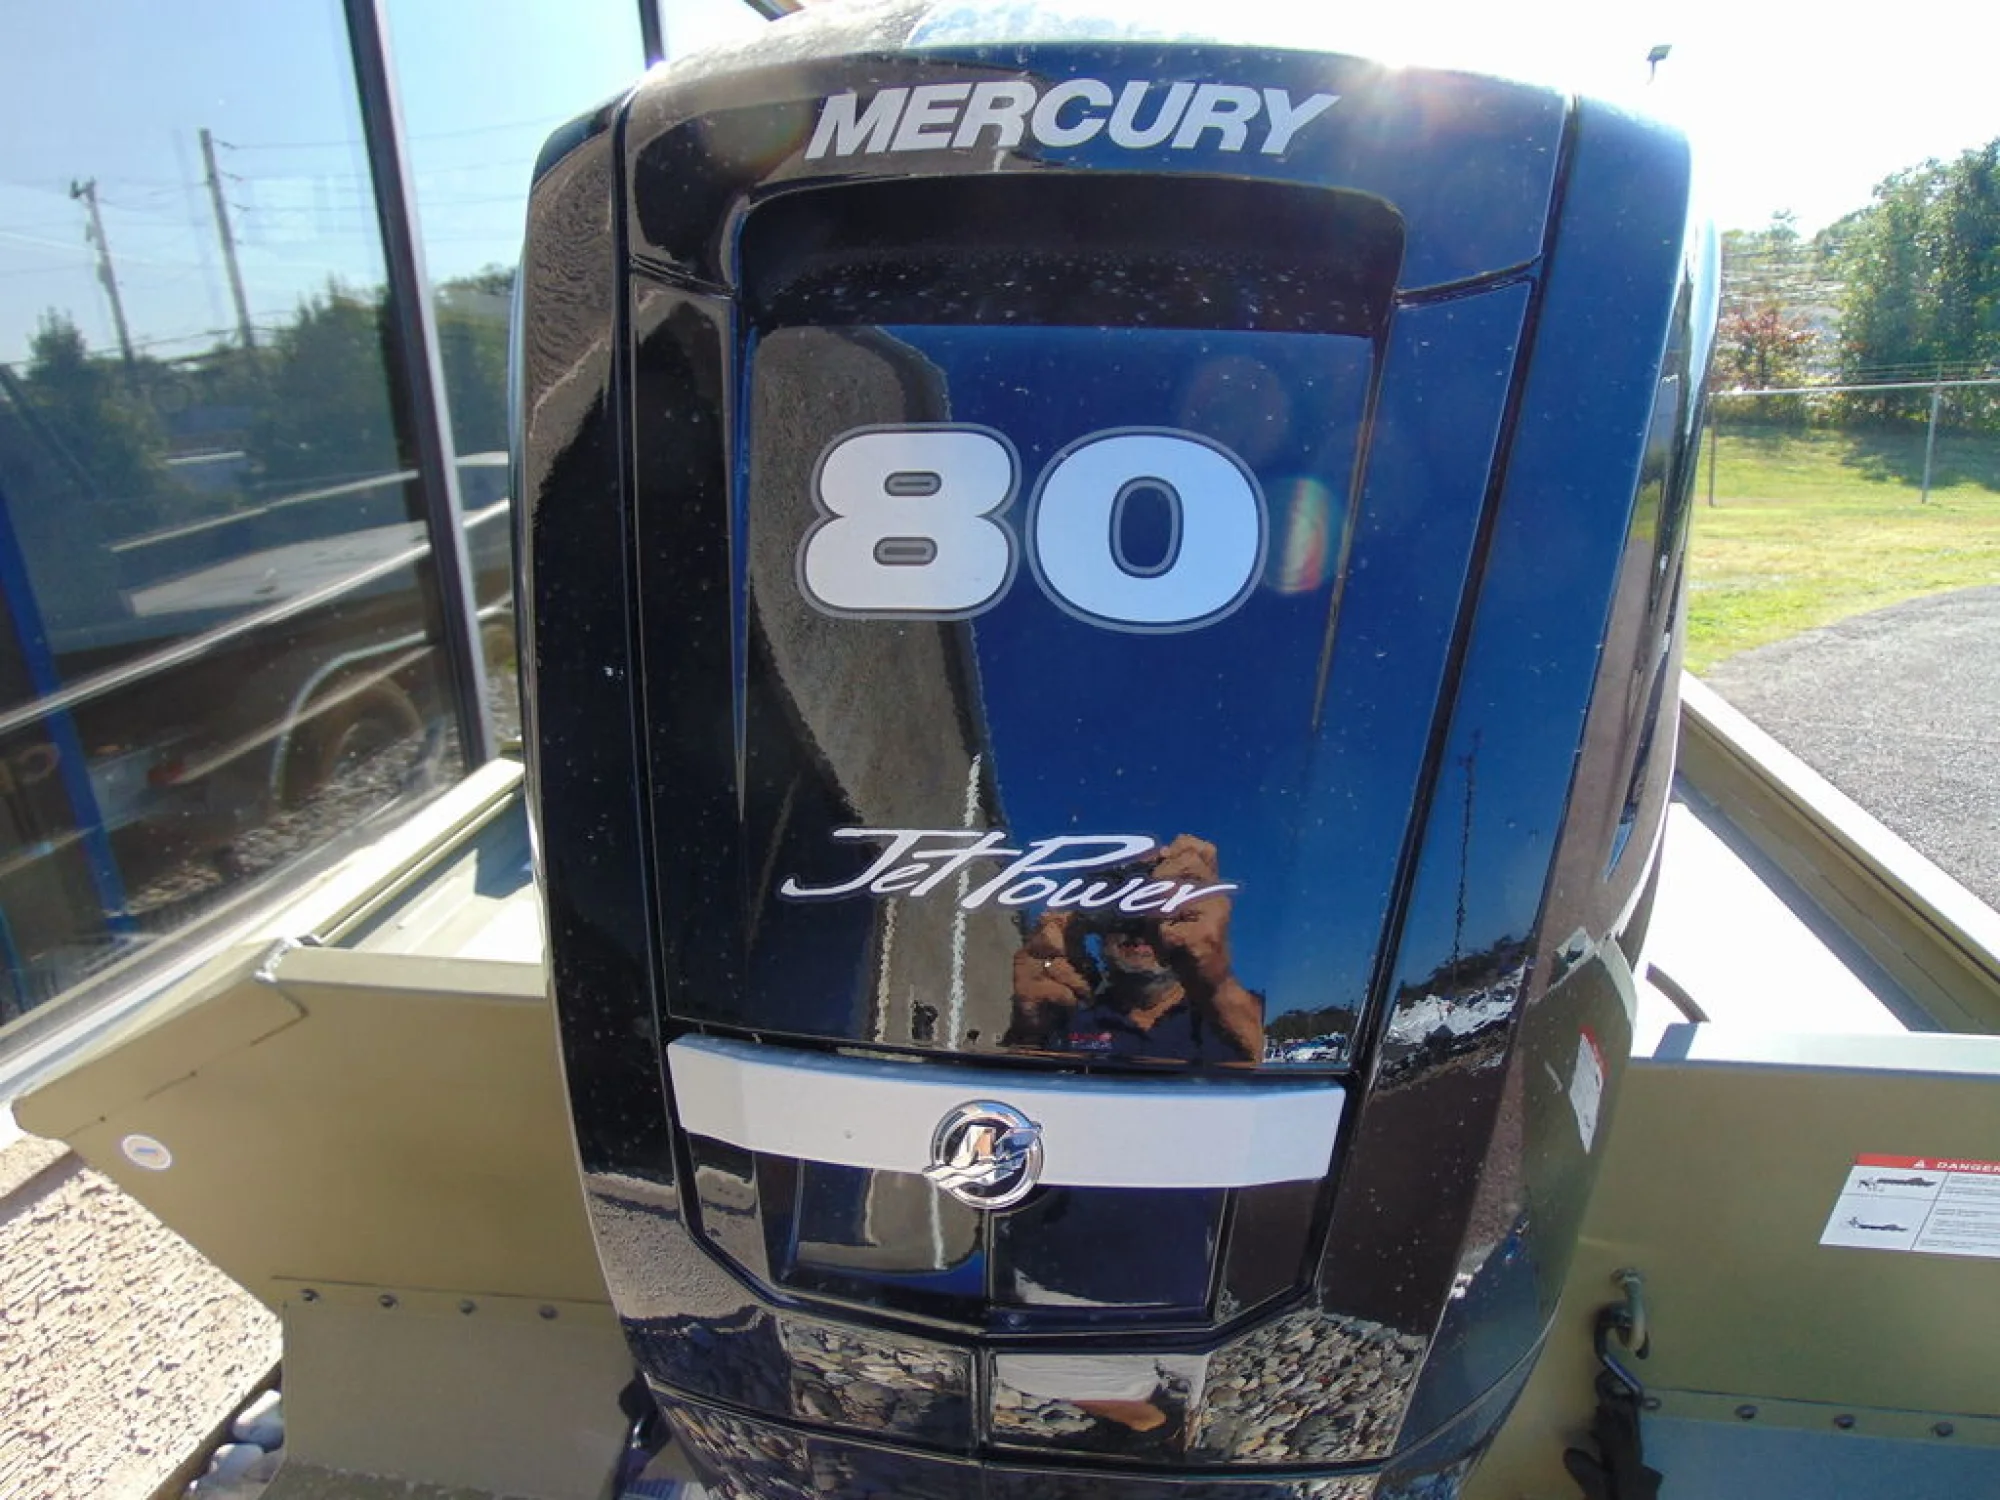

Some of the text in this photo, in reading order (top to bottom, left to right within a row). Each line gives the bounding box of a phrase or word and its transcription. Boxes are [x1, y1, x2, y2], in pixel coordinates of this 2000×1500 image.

[804, 78, 1340, 160] MERCURY
[797, 422, 1270, 633] 80
[1936, 1161, 2000, 1173] DANGER
